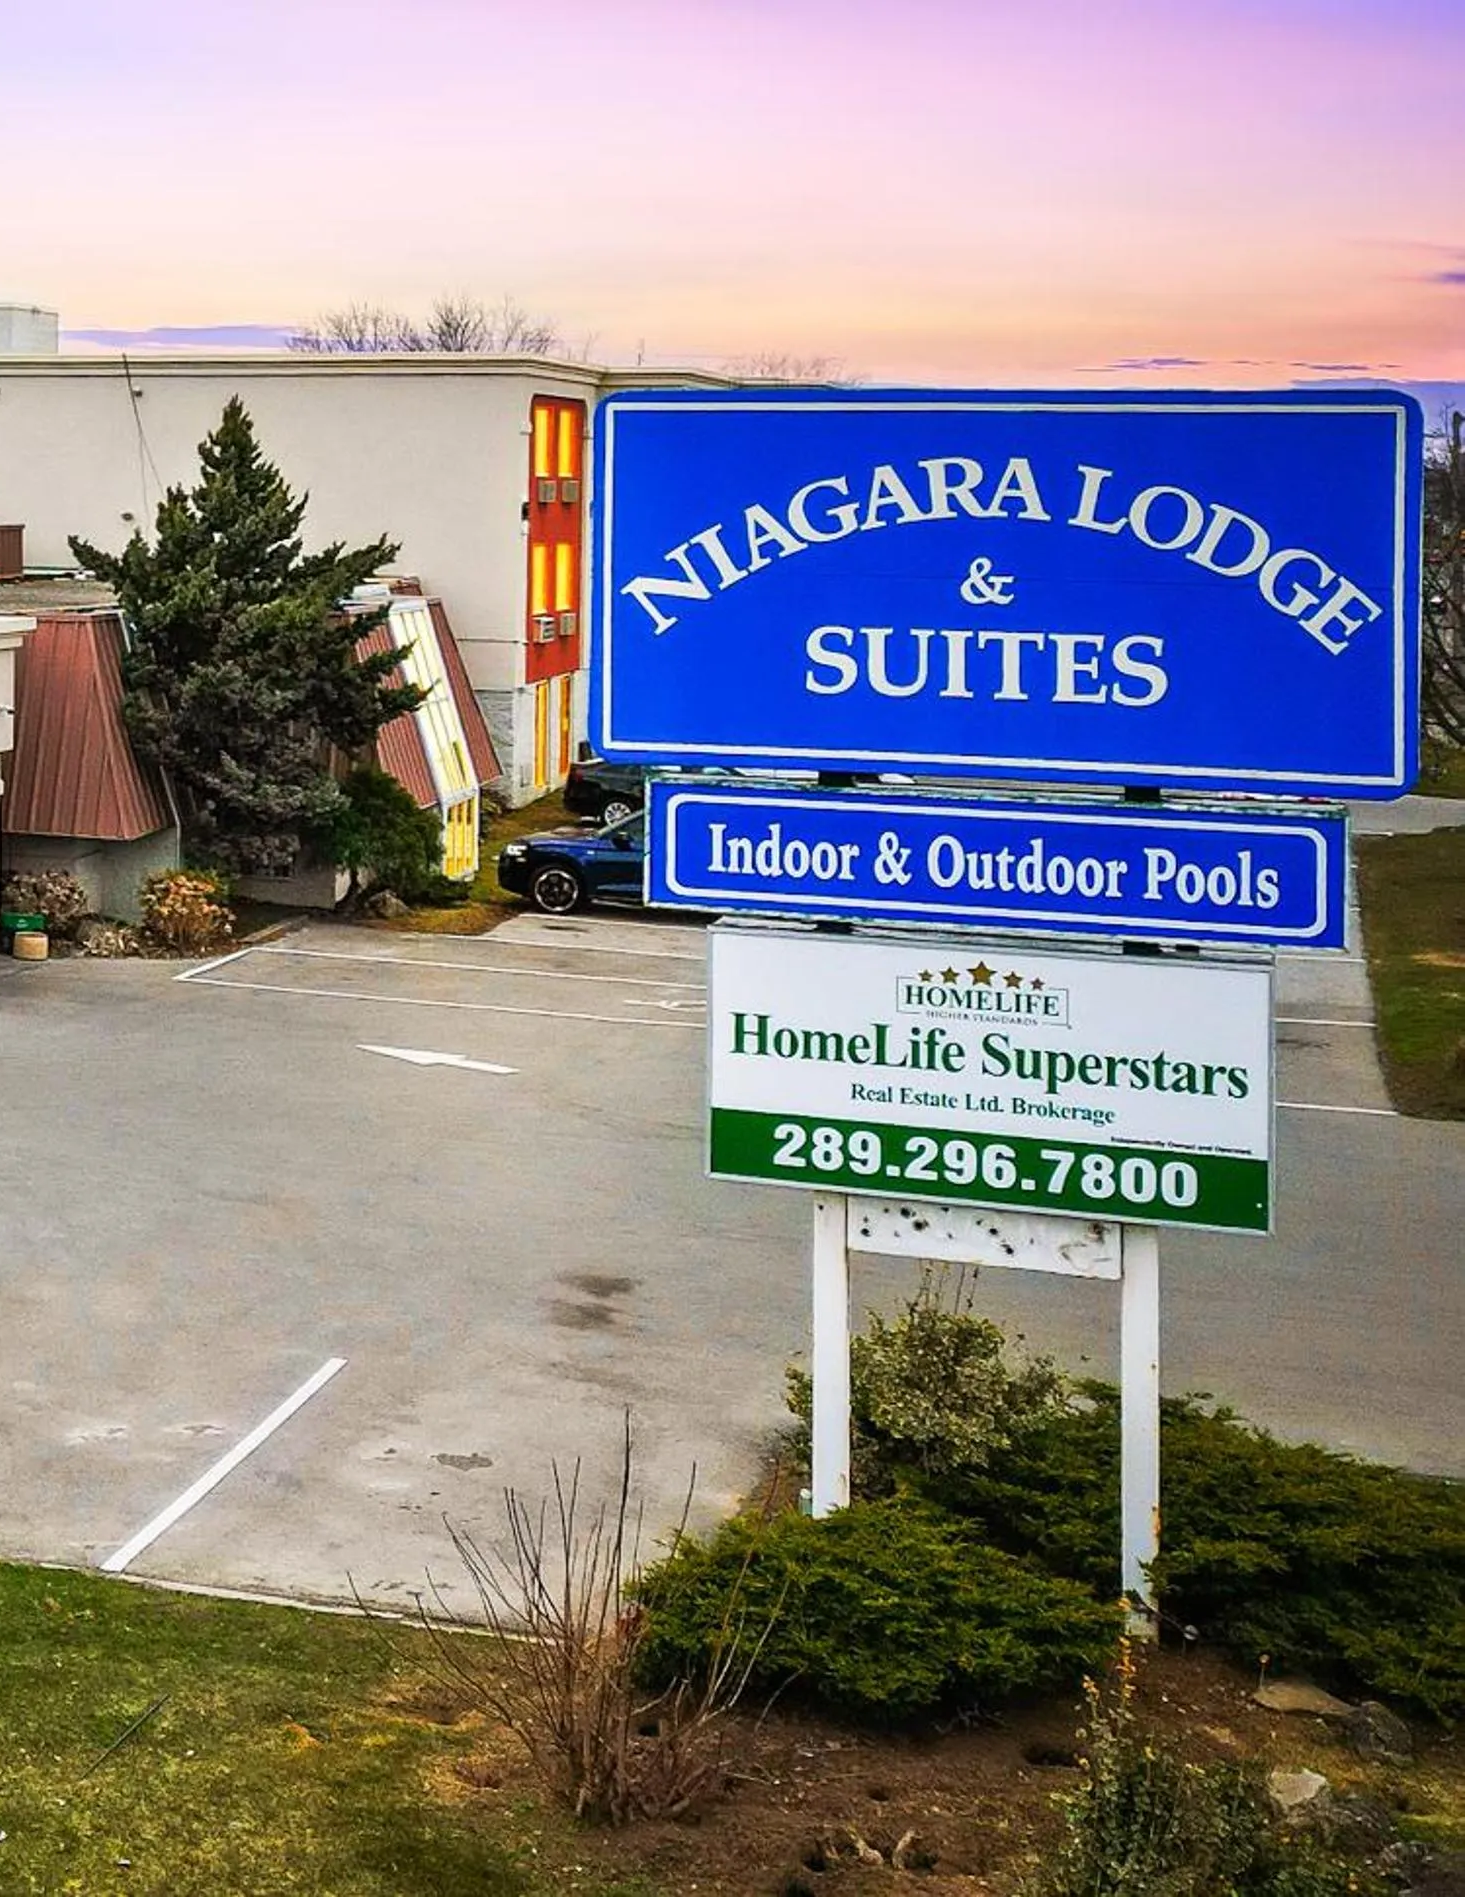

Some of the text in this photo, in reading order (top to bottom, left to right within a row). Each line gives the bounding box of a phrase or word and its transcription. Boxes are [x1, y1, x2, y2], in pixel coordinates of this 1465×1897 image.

[621, 457, 1383, 656] NIAGARA LODGE
[960, 556, 1014, 605] &
[805, 625, 1169, 707] SUITES
[708, 823, 1279, 909] Indoor & Outdoor Pools
[905, 985, 1060, 1017] HOMELIFE
[730, 1011, 1249, 1099] HomeLife Superstars
[851, 1083, 1116, 1127] Real Estate Ltd. Brokerage
[772, 1123, 1198, 1207] 289.296.7800
